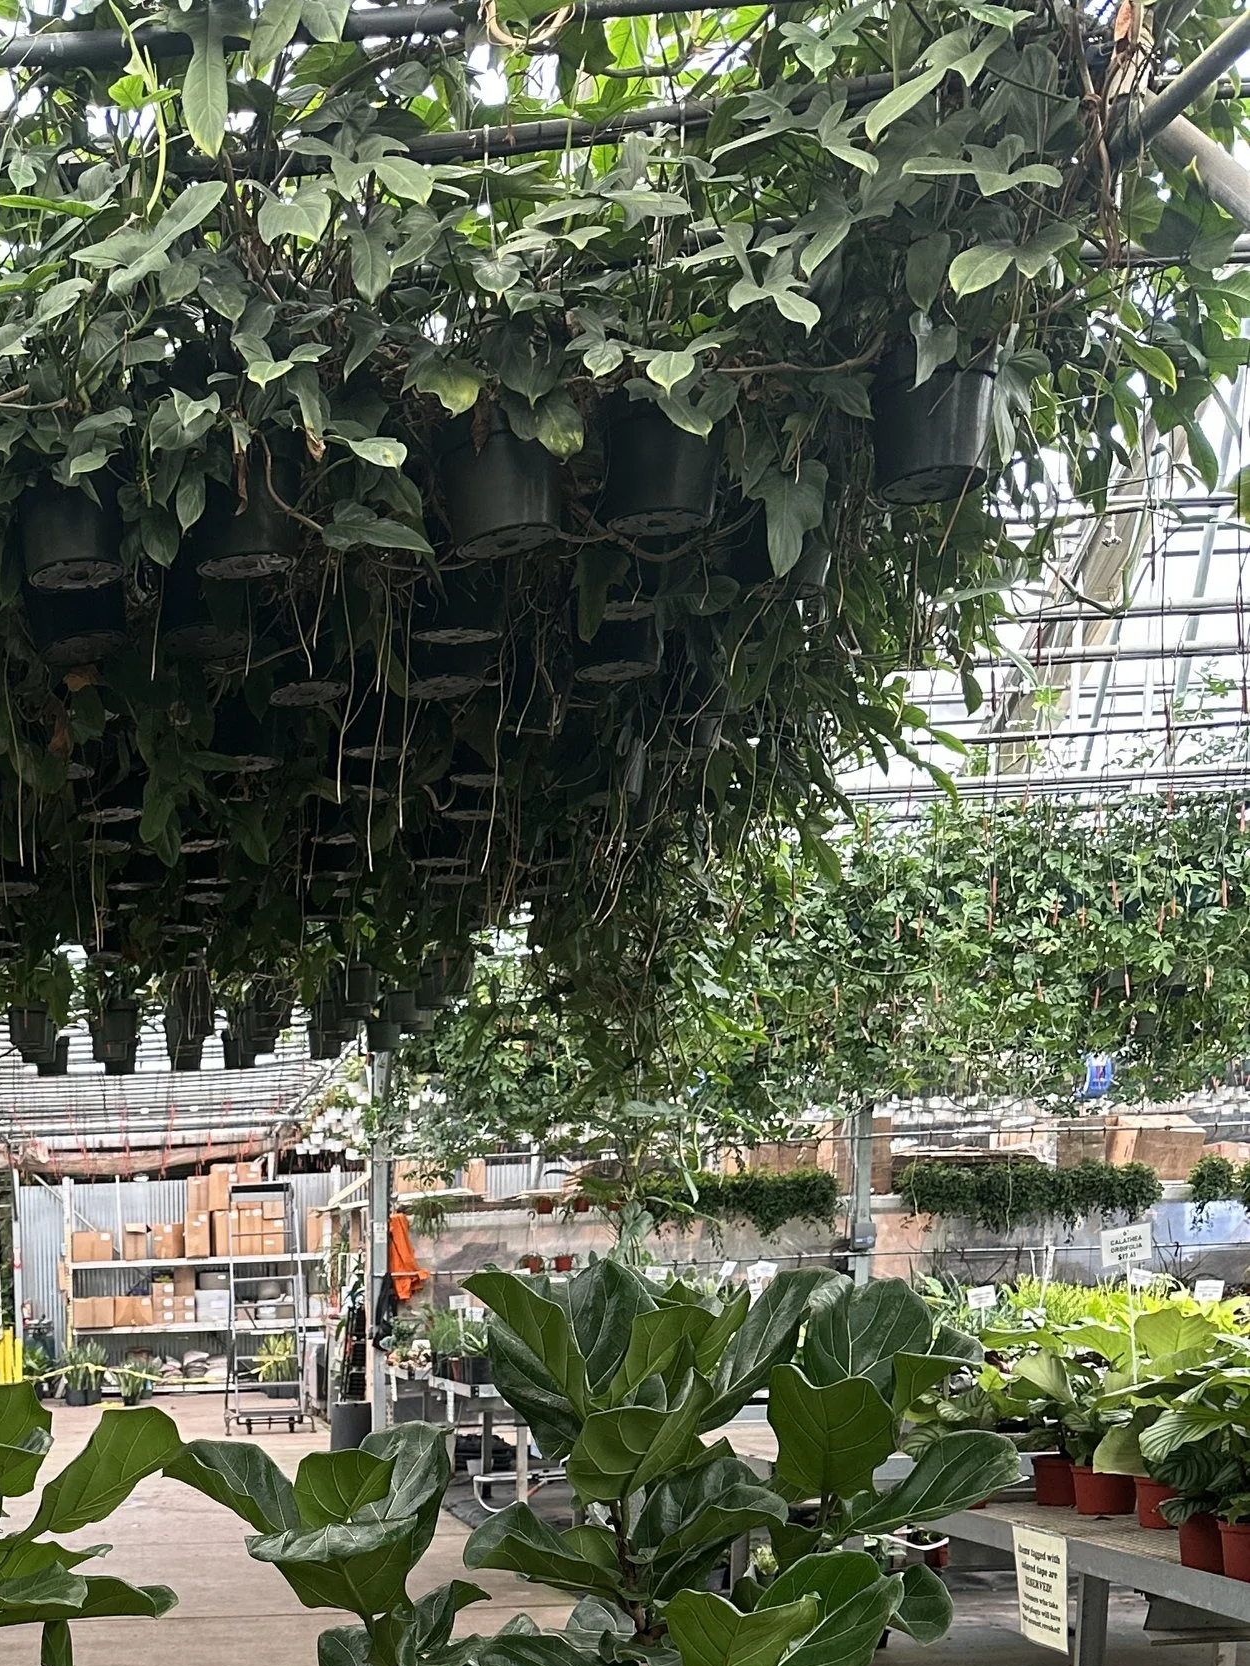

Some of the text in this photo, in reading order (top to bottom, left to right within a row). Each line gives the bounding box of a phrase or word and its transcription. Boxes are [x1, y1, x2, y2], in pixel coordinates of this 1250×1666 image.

[1110, 1235, 1143, 1246] CALATHEA
[1047, 1553, 1061, 1564] with
[1048, 1571, 1058, 1579] are
